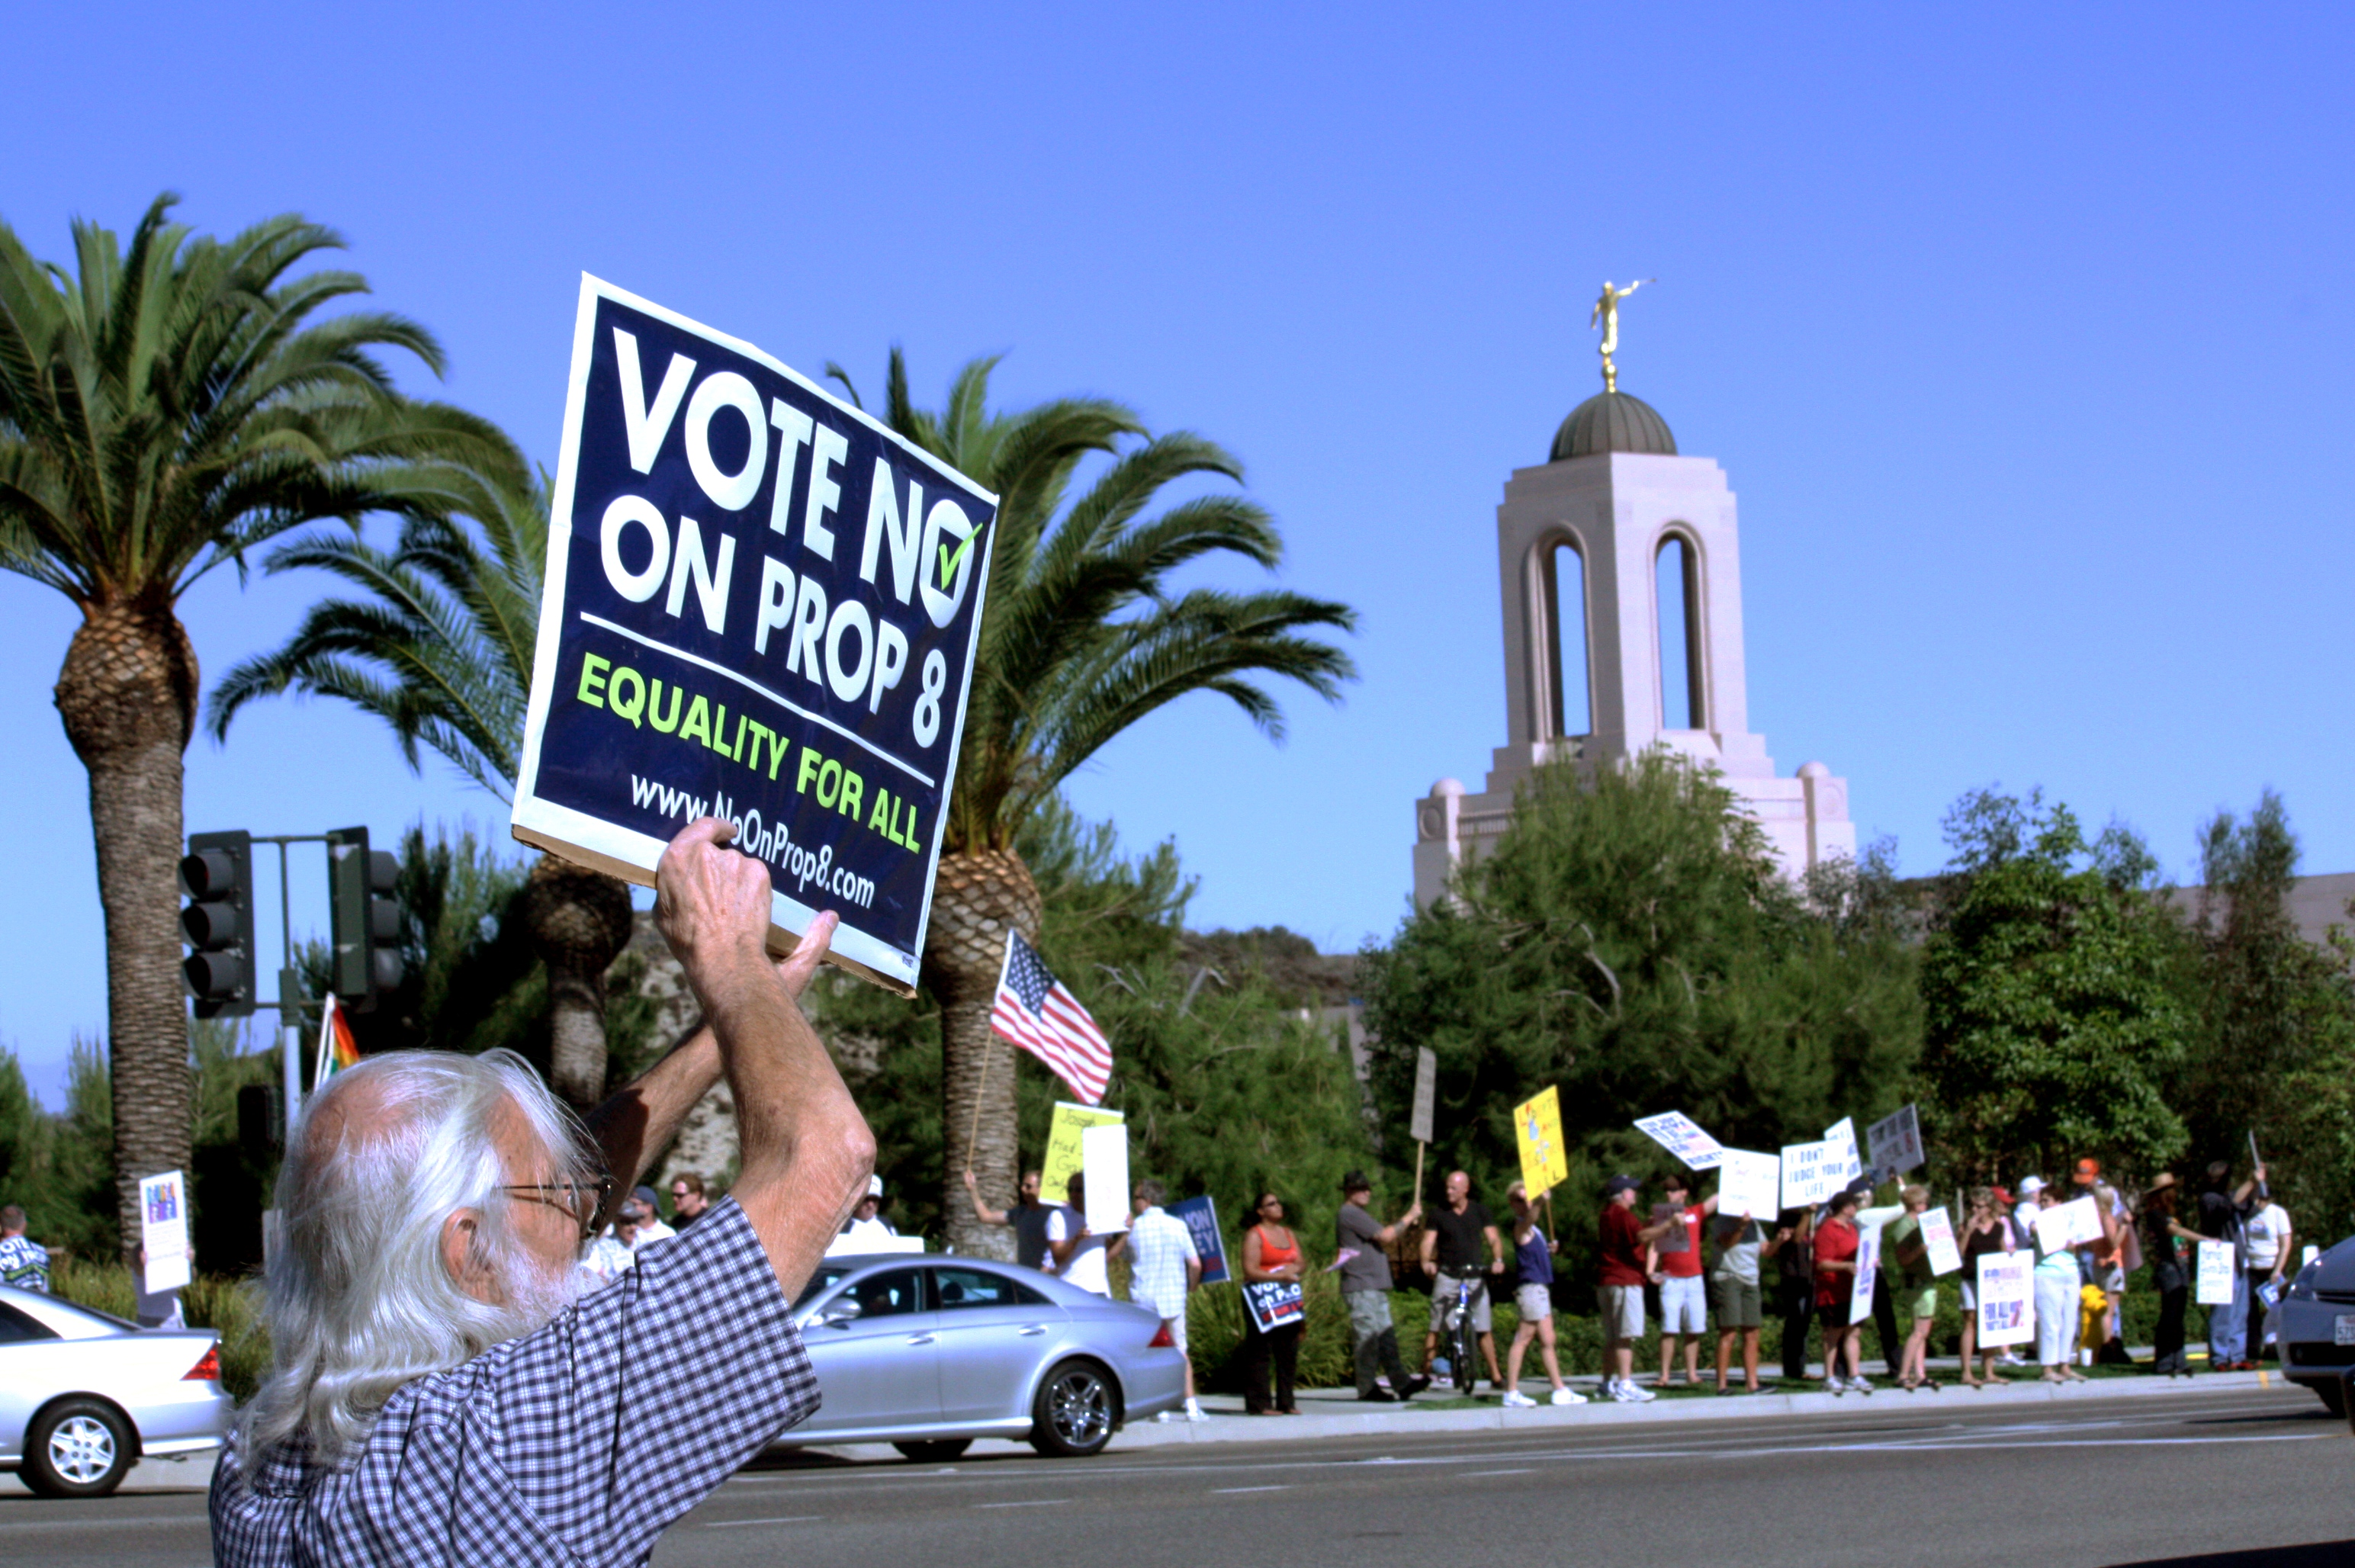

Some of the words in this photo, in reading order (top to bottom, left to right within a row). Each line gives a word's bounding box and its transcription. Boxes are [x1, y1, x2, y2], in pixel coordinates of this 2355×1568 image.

[613, 326, 848, 562] VOTE
[859, 456, 975, 629] NO
[600, 494, 736, 635] ON
[754, 555, 909, 715] PROP
[913, 649, 946, 748] 8
[577, 651, 789, 780] EQUALITY
[796, 746, 863, 821] FOR
[868, 788, 920, 854] ALL
[631, 773, 875, 909] wwwNoOnProp8.com
[1789, 1167, 1815, 1183] JUDGE
[1822, 1162, 1843, 1176] YOUR
[1800, 1147, 1824, 1164] DON'T
[1805, 1182, 1823, 1197] LIFE
